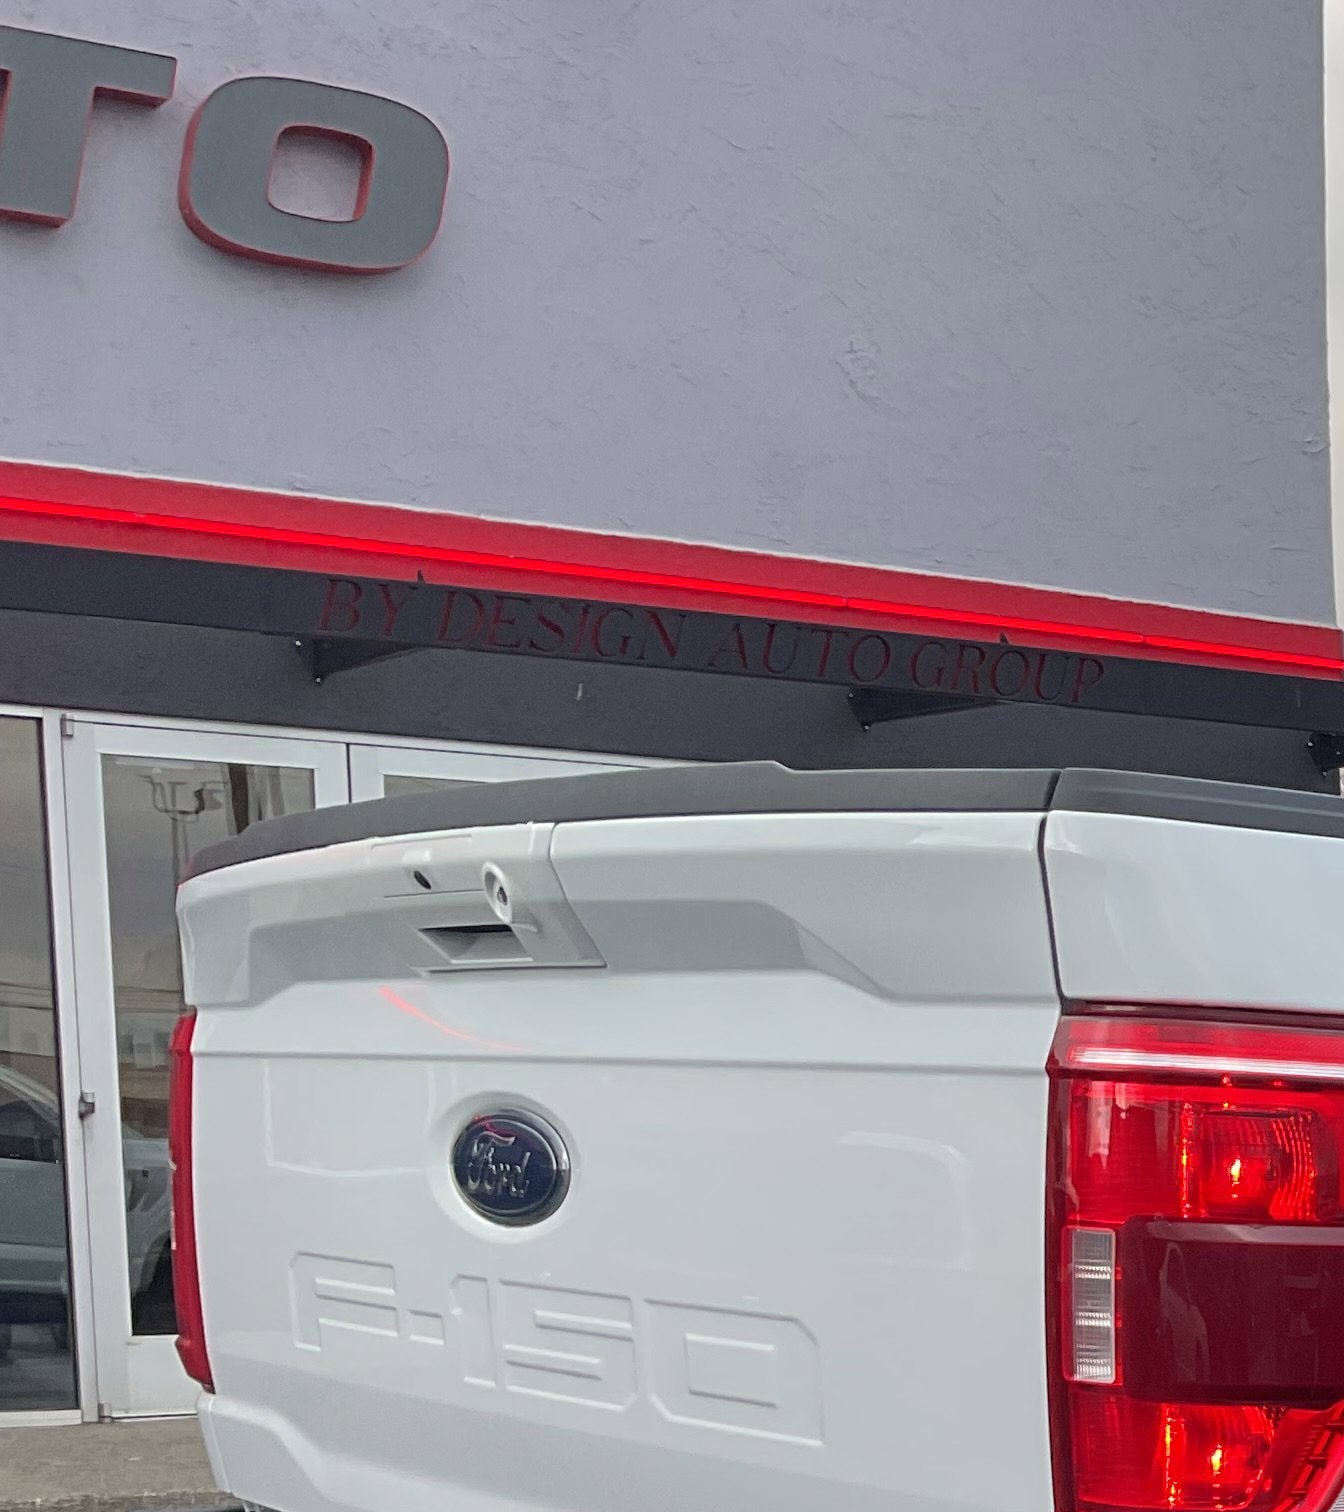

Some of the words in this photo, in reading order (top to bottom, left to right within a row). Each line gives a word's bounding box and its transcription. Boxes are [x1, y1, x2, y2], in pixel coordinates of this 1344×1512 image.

[319, 578, 418, 637] BY
[436, 589, 686, 660] DESIGN
[706, 622, 892, 683] AUTO
[910, 640, 1104, 702] GROUP
[288, 1251, 824, 1448] F-150
